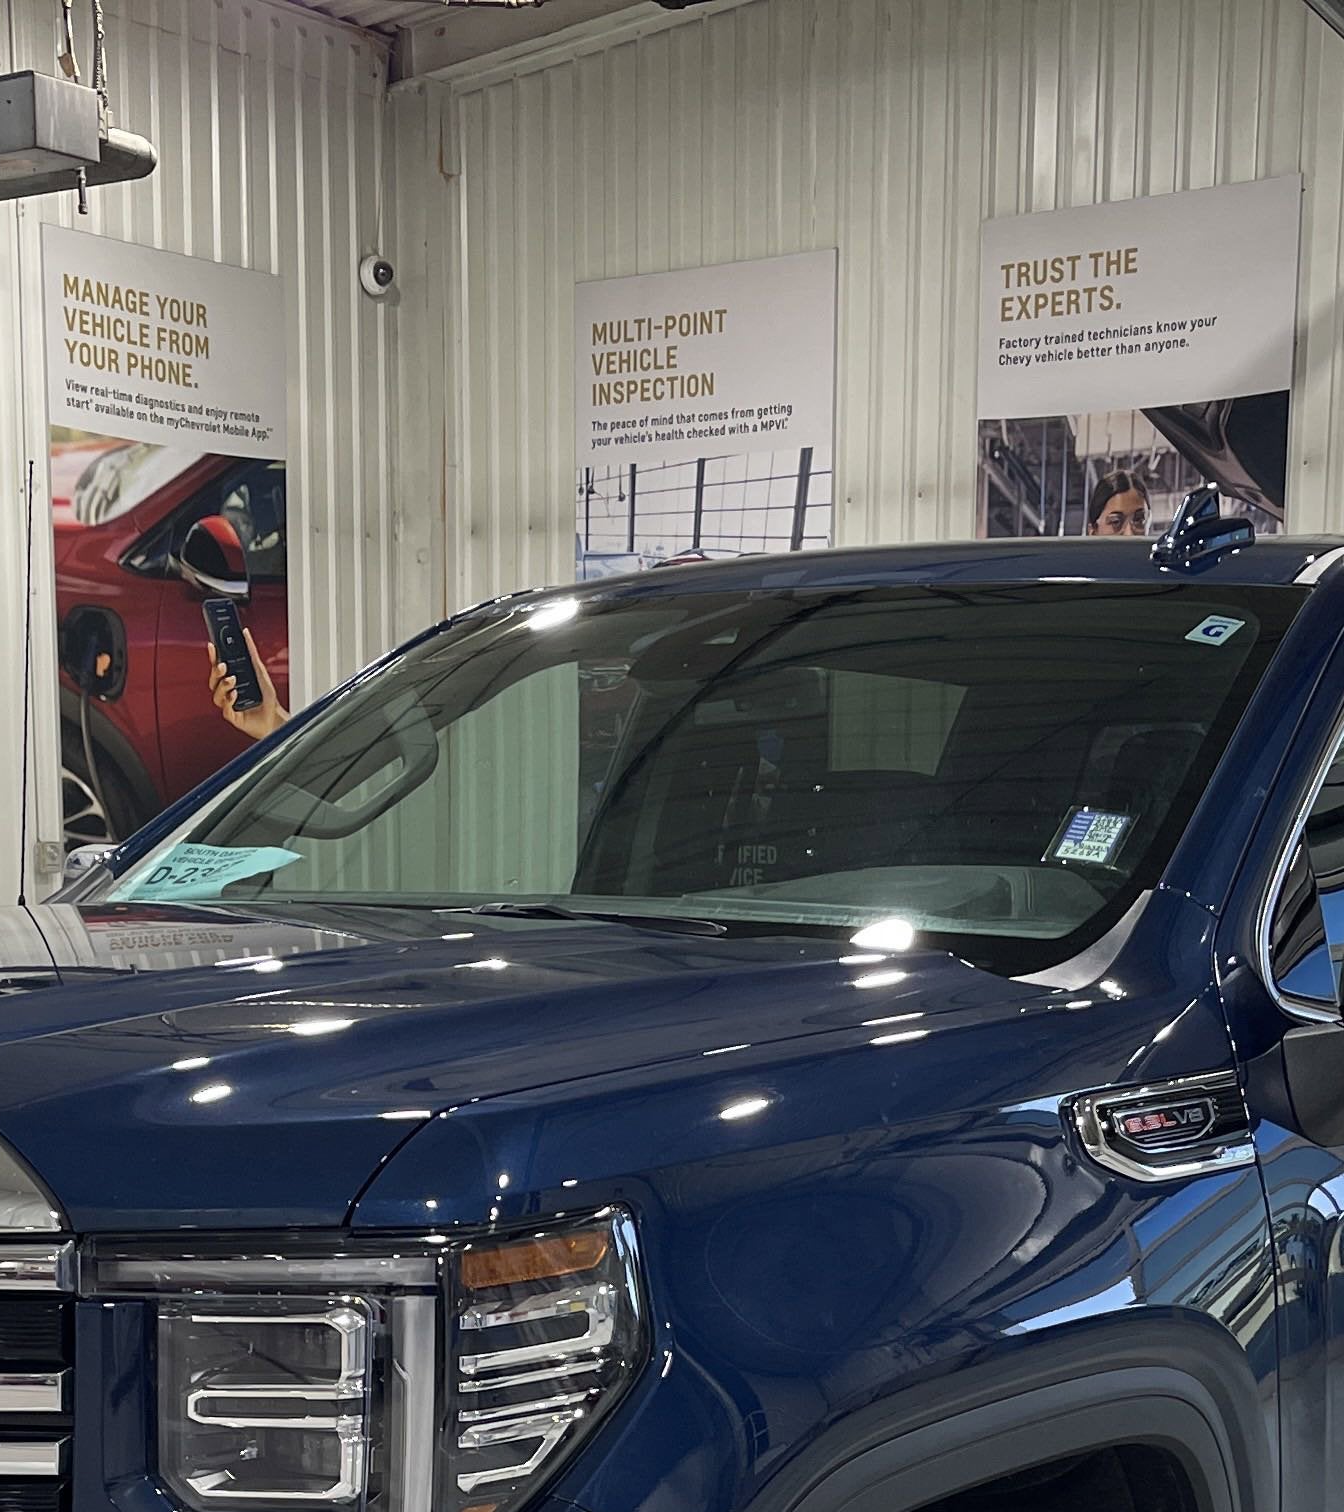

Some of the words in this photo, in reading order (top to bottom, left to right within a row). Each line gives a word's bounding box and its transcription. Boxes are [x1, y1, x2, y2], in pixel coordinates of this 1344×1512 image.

[1001, 254, 1081, 289] TRUST
[1089, 247, 1138, 278] THE
[63, 273, 150, 317] MANAGE
[155, 294, 208, 329] YOUR
[1000, 285, 1122, 322] EXPERTS.
[64, 306, 150, 349] VEHICLE
[157, 326, 209, 360] FROM
[592, 309, 728, 346] MULTI-POINT
[999, 331, 1041, 350] Factory
[1044, 329, 1084, 346] trained
[1087, 323, 1153, 343] technicians
[1156, 318, 1187, 333] know
[1190, 316, 1218, 332] your
[64, 338, 120, 374] YOUR
[127, 351, 199, 389] PHONE.
[591, 345, 678, 376] VEHICLE
[998, 352, 1032, 367] Chevy
[1034, 349, 1074, 364] vehicle
[1076, 345, 1112, 360] better
[1115, 342, 1141, 355] than
[1144, 337, 1189, 354] anyone.
[65, 378, 88, 394] View
[90, 385, 133, 404] real-time
[135, 392, 186, 413] diagnostics
[188, 402, 203, 416] and
[205, 406, 228, 423] enjoy
[229, 410, 260, 423] remote
[592, 372, 715, 407] INSPECTION
[94, 401, 135, 421] available
[136, 411, 148, 422] on
[150, 411, 165, 425] the
[166, 416, 221, 434] myChevrolet
[223, 423, 250, 438] Mobile
[591, 435, 612, 449] your
[614, 426, 653, 445] vehicle's
[655, 425, 685, 442] health
[687, 424, 725, 439] checked
[728, 421, 750, 434] with
[752, 423, 758, 432] a
[592, 420, 609, 432] The
[610, 418, 637, 432] peace
[639, 415, 649, 427] of
[651, 413, 674, 426] mind
[676, 413, 695, 424] that
[698, 411, 729, 422] comes
[731, 407, 755, 419] from
[757, 403, 793, 420] getting
[1173, 1107, 1204, 1125] V8
